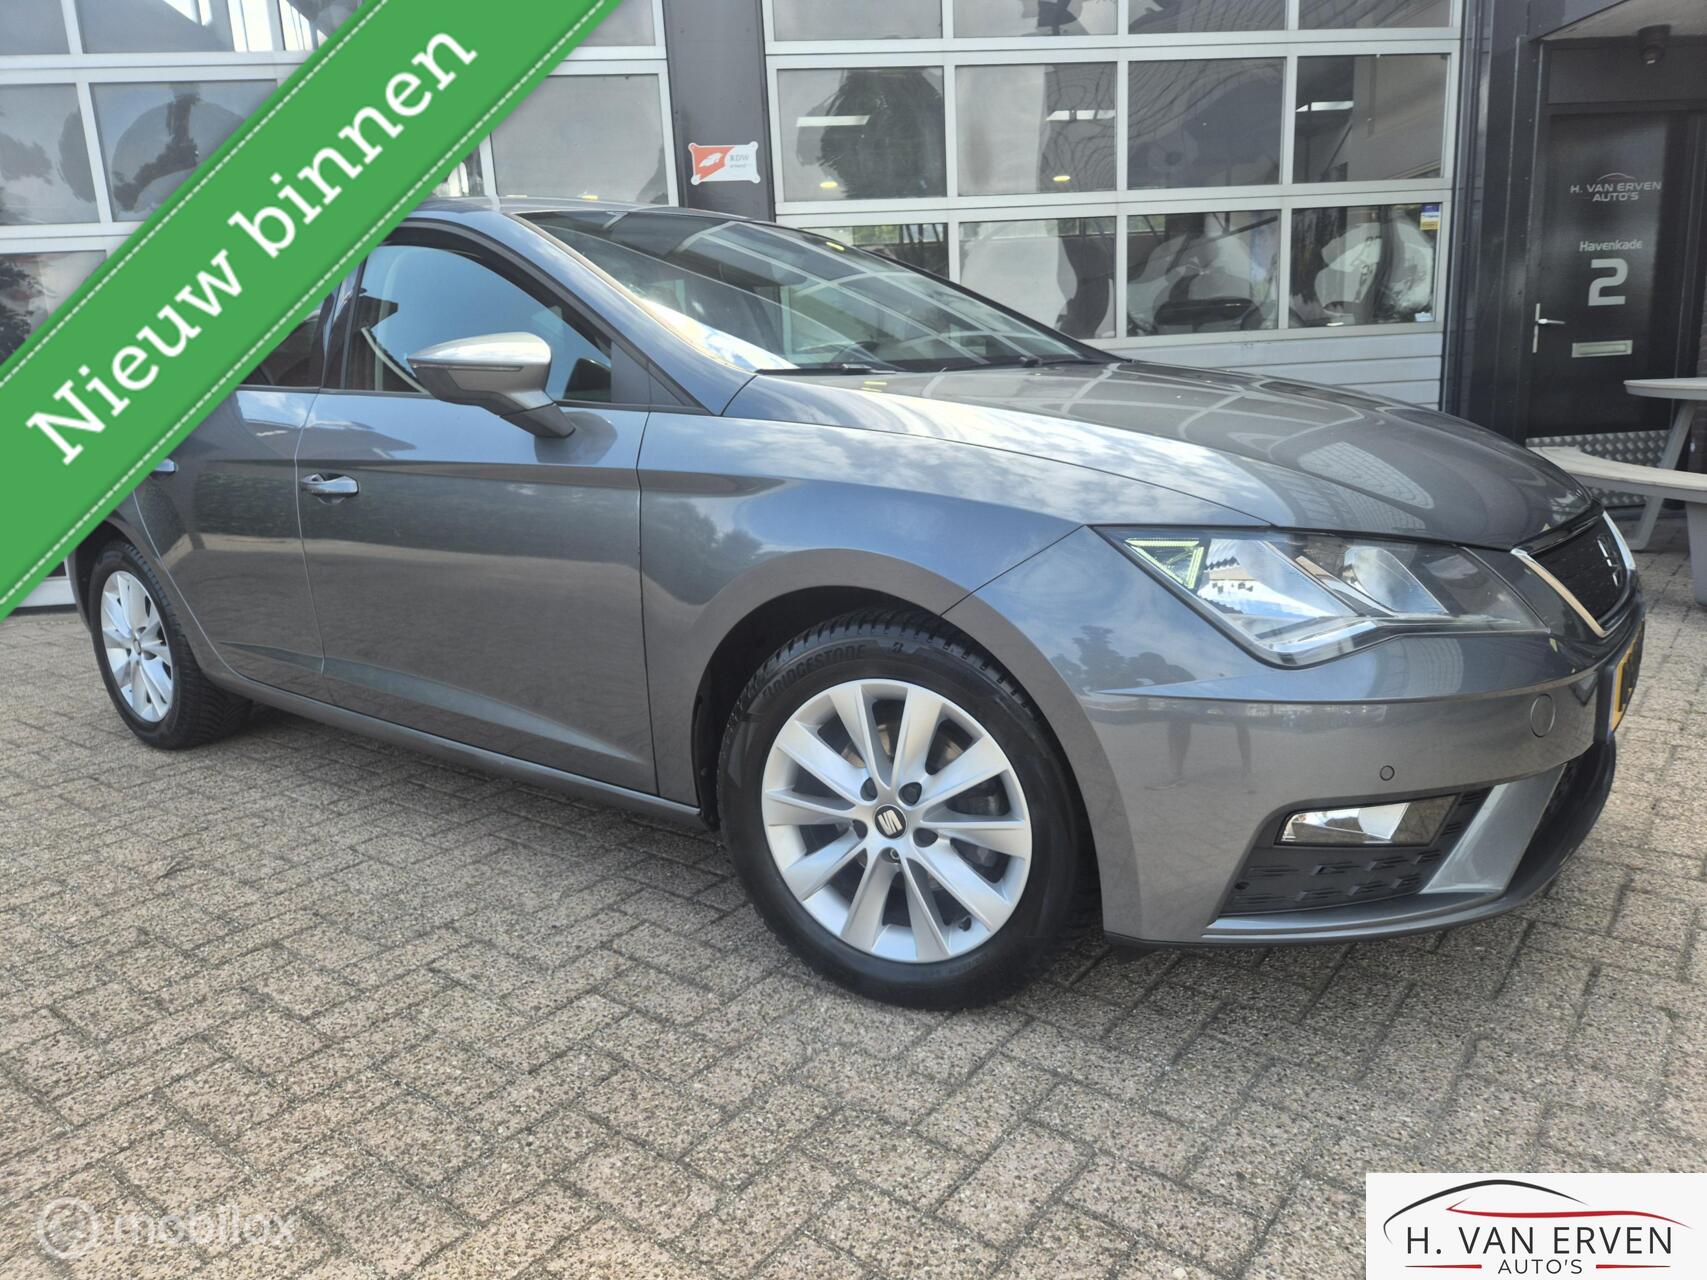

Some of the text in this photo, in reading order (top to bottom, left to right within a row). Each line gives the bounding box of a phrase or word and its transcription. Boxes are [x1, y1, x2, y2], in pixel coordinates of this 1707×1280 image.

[1569, 181, 1662, 194] H. VAN ERVEN
[1592, 191, 1639, 202] AUTO'S
[1578, 238, 1644, 253] Havenkade
[1587, 257, 1629, 307] 2
